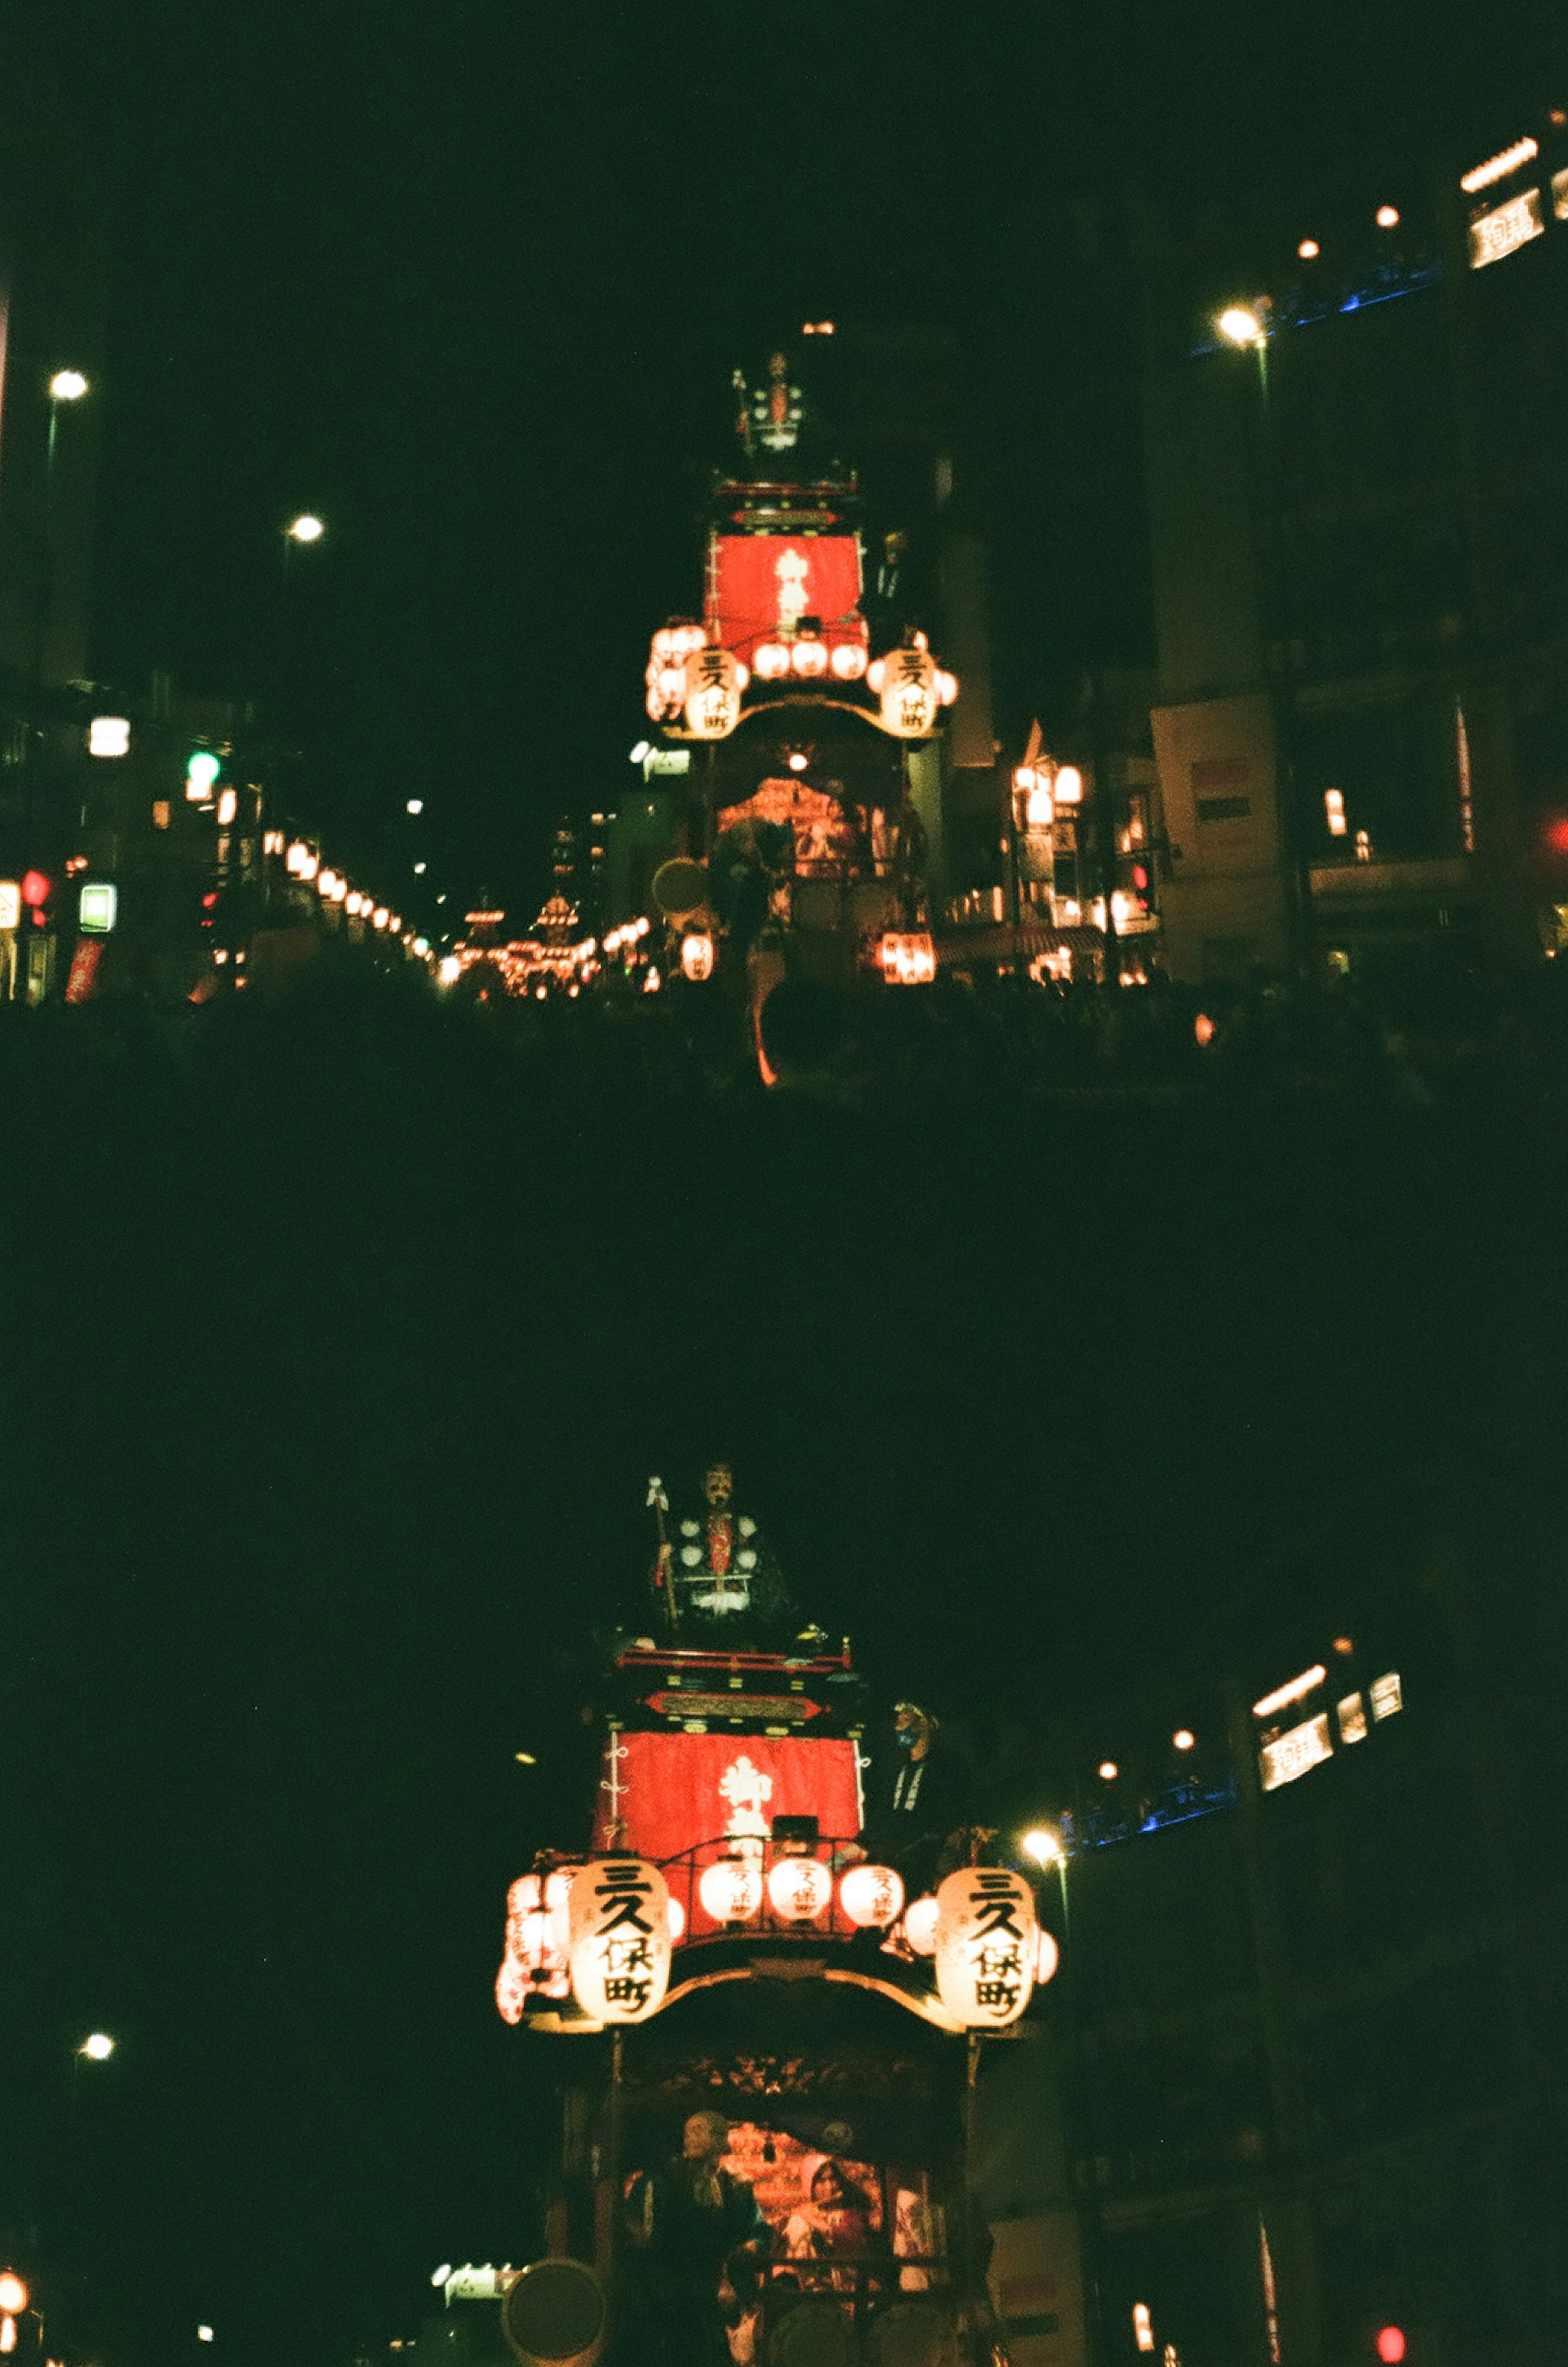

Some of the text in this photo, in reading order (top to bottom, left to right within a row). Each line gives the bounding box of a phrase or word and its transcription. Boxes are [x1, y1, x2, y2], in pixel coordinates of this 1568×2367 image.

[791, 1862, 817, 1914] 三久保町
[871, 1868, 894, 1919] 三久保町
[595, 1865, 654, 2013] 三久保町
[968, 1874, 1023, 2017] 三久保町
